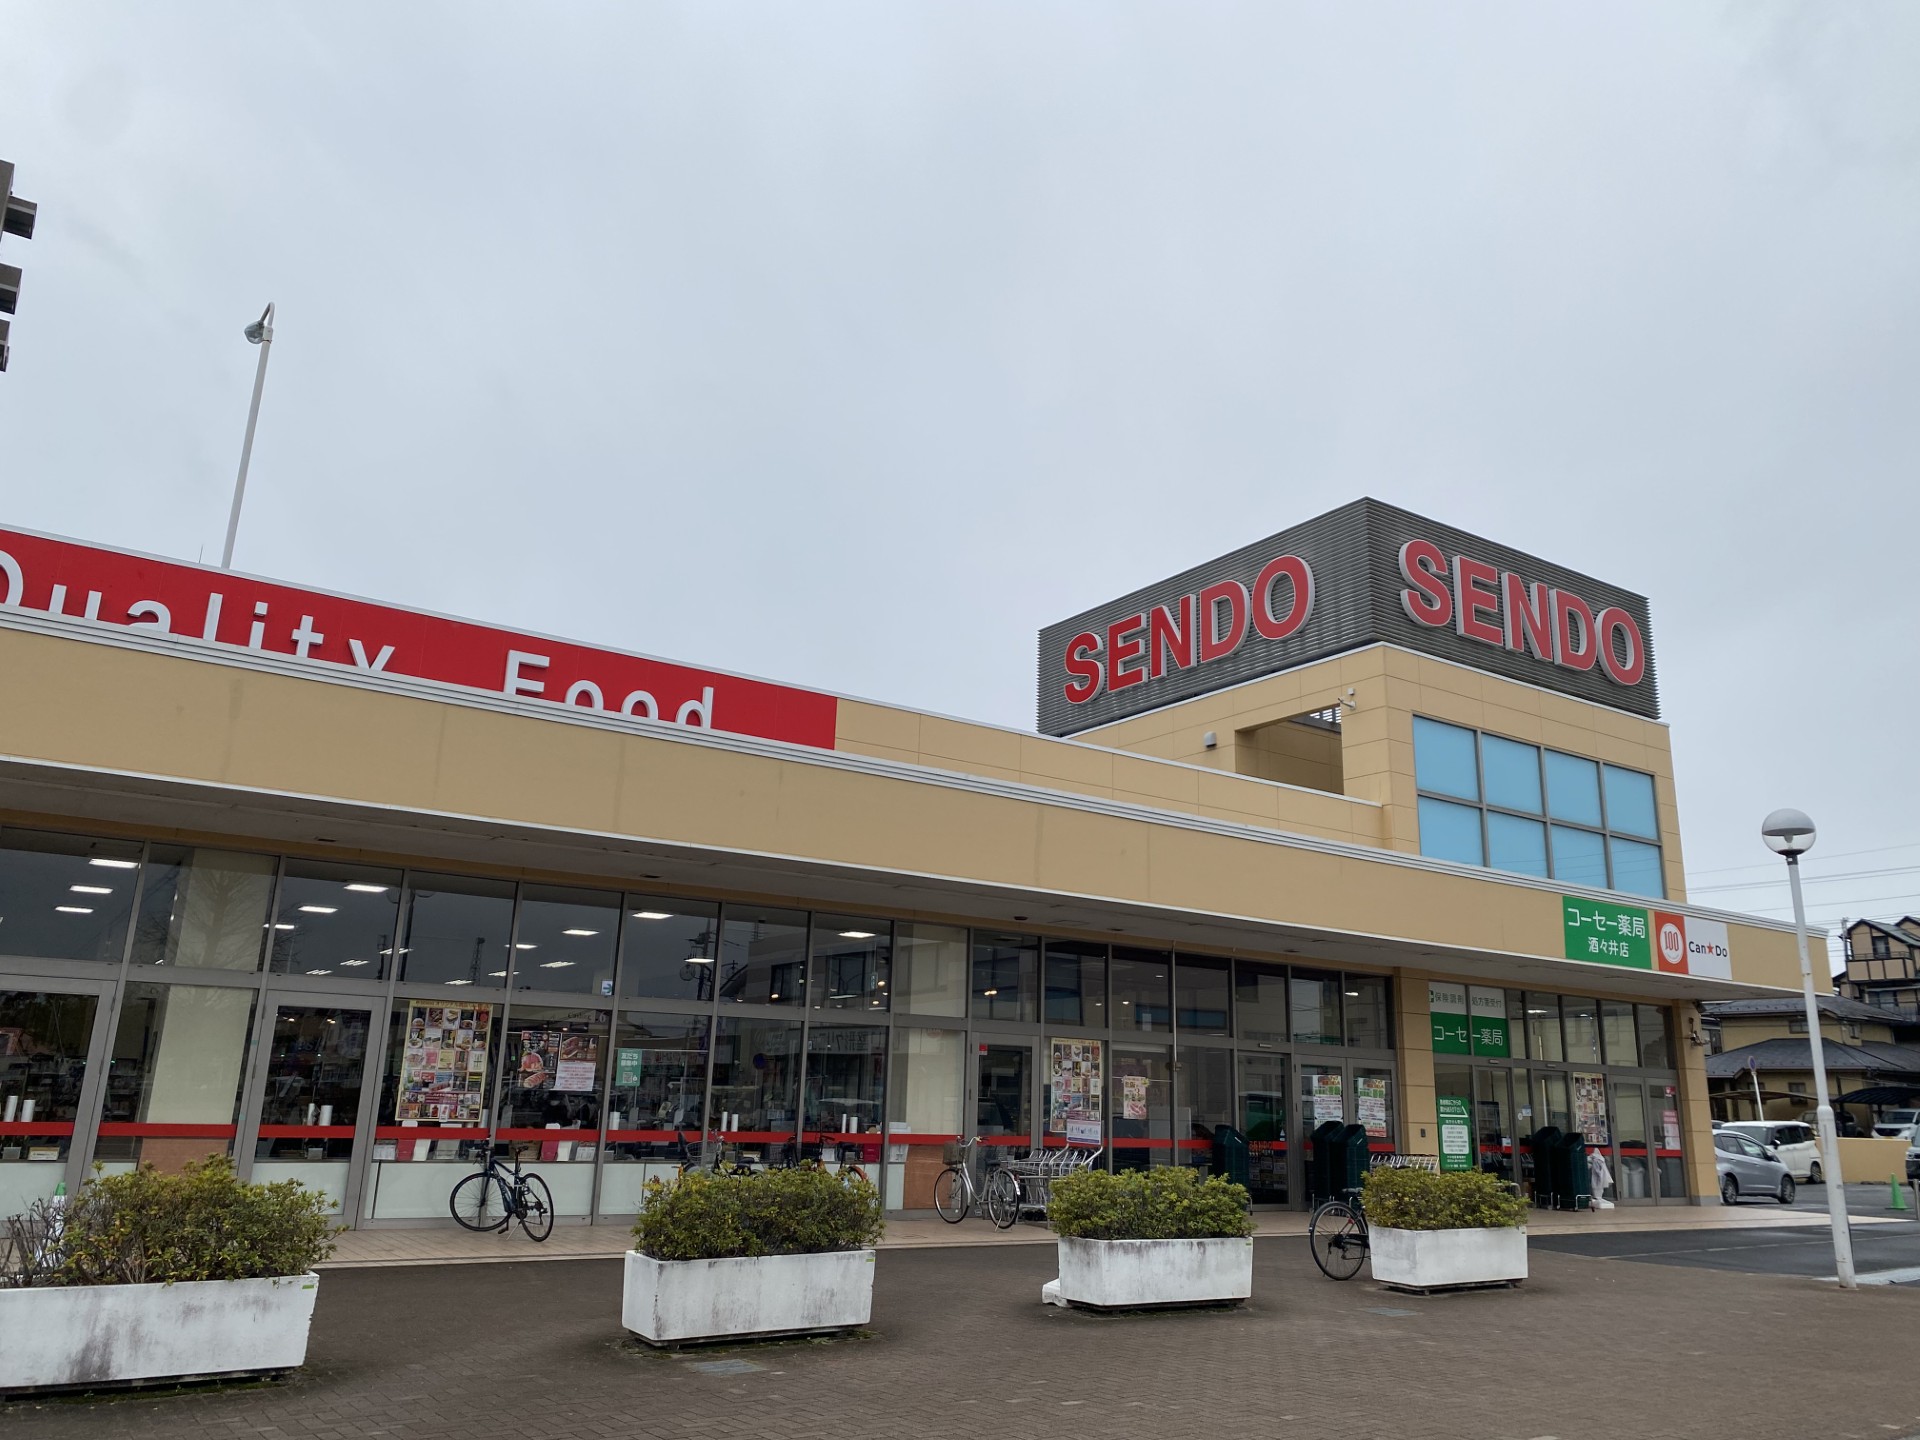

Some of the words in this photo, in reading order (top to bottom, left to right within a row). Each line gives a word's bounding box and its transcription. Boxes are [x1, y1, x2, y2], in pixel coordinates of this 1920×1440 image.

[1399, 539, 1646, 685] SENDO
[1064, 555, 1315, 704] SENDO
[1567, 908, 1646, 938] コーセー薬局
[1588, 936, 1629, 958] 酒々井店
[1664, 931, 1679, 952] 100
[1433, 1025, 1503, 1046] コーセー薬局
